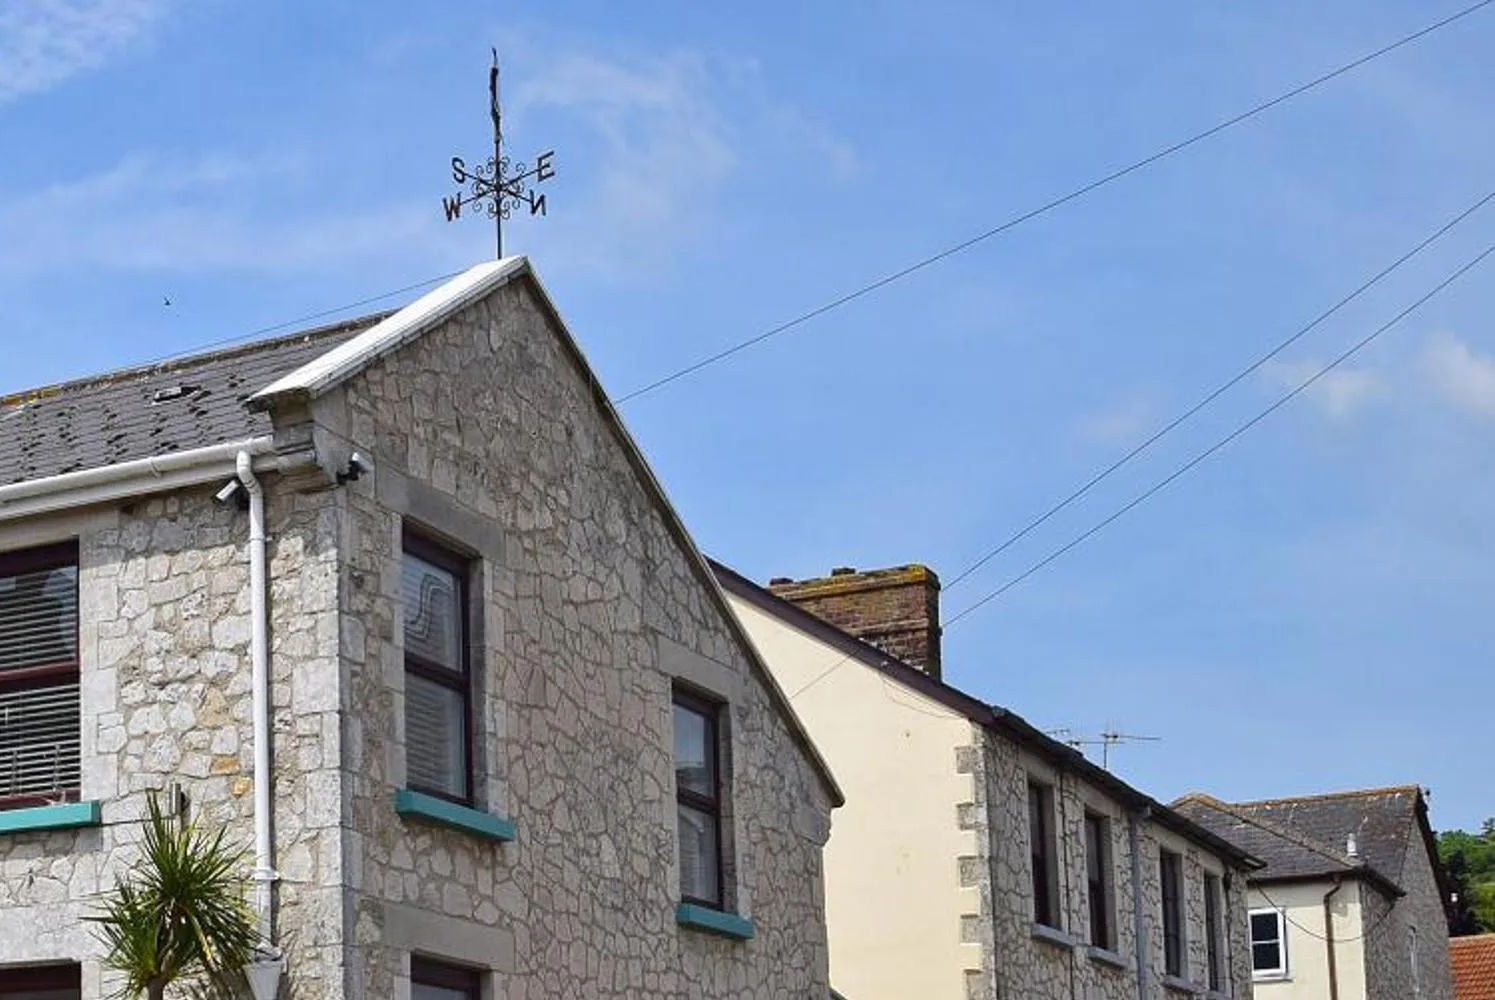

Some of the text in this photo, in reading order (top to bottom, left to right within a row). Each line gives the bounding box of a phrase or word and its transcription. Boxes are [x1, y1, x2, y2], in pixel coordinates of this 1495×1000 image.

[451, 156, 465, 184] S
[537, 150, 555, 182] E
[443, 191, 461, 222] W
